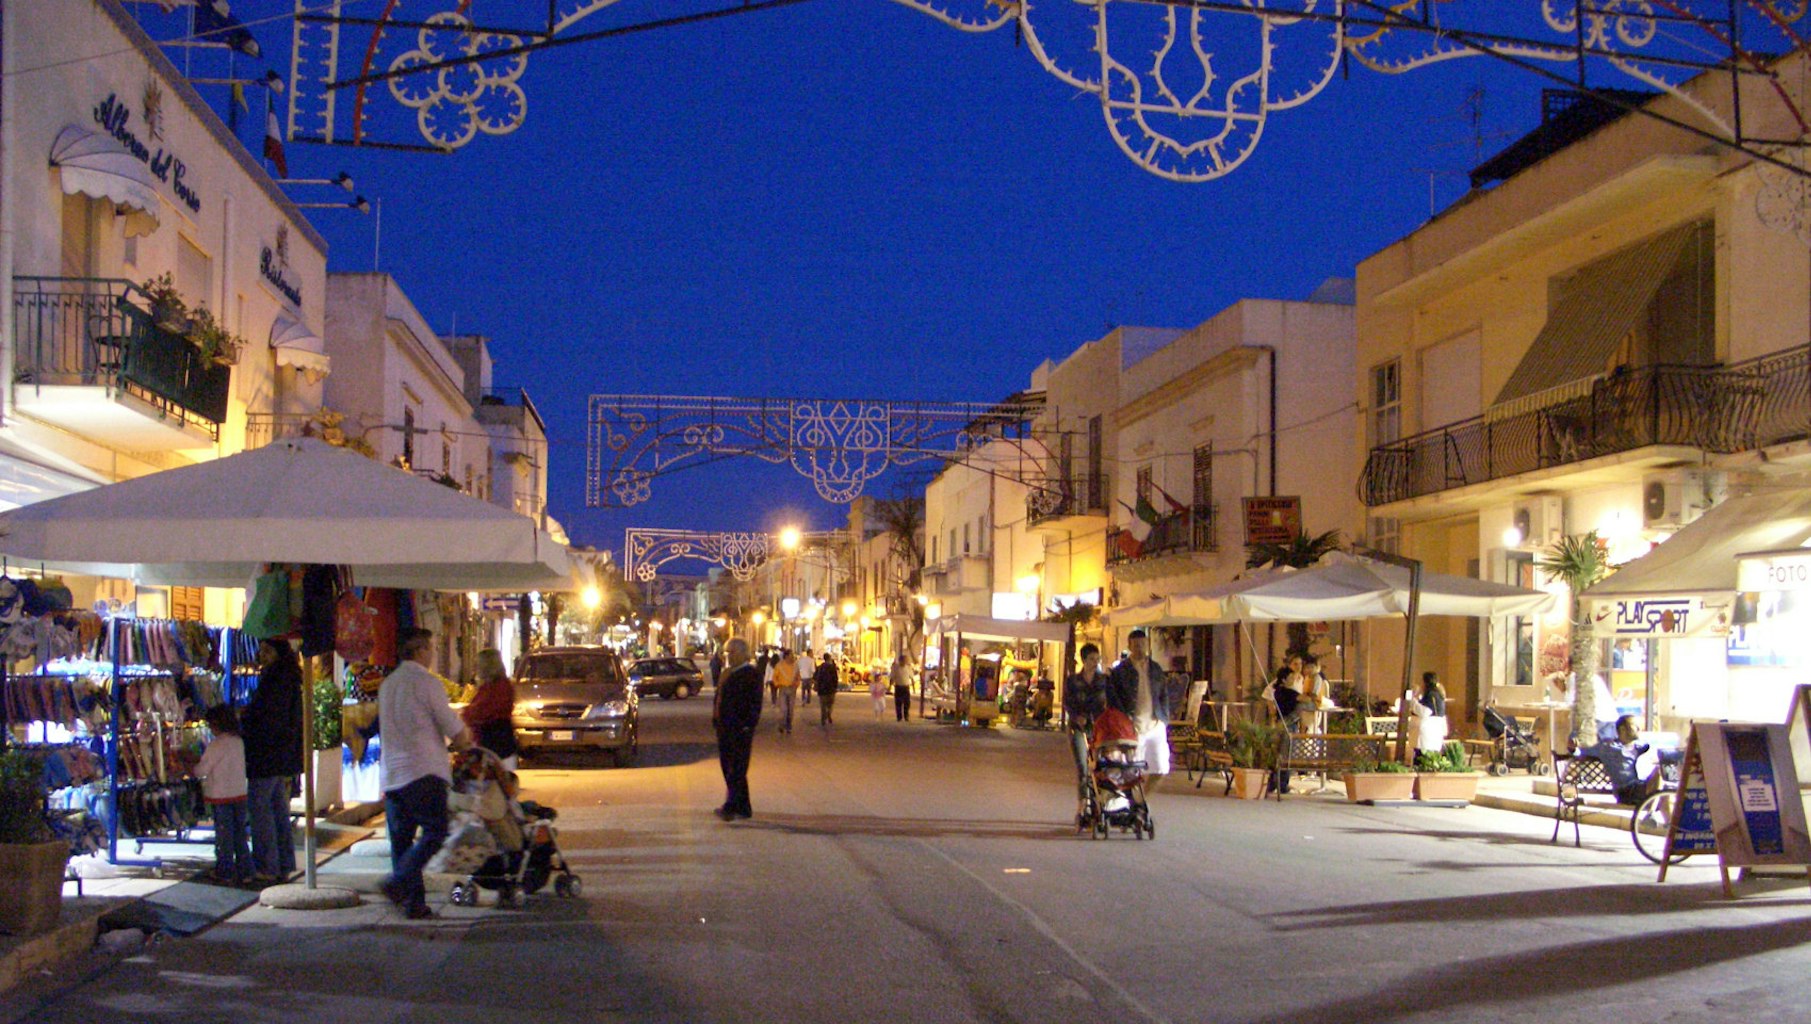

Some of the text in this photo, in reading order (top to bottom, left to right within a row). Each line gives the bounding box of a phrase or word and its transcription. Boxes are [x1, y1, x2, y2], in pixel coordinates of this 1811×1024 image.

[150, 148, 174, 183] del
[173, 158, 201, 214] Corso
[1768, 564, 1808, 584] FOTO
[1616, 600, 1690, 634] PLAY SPORT
